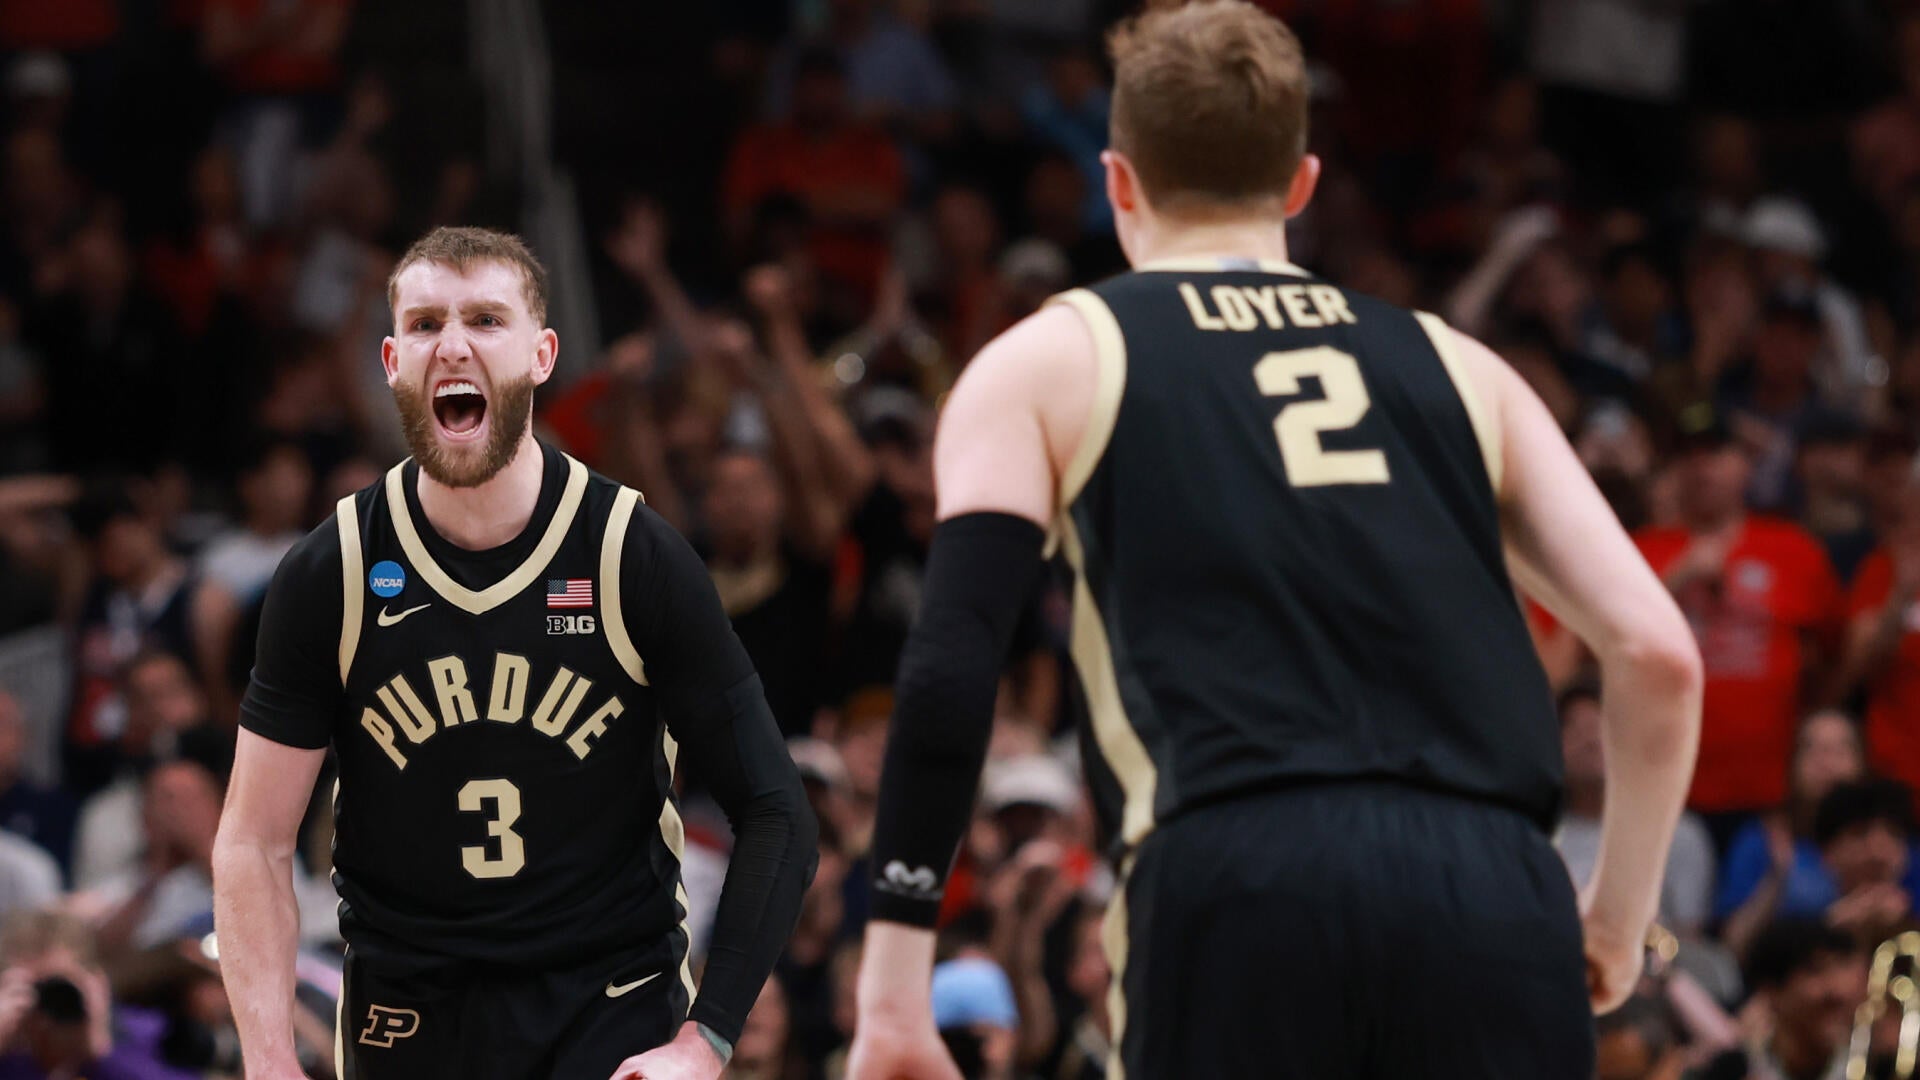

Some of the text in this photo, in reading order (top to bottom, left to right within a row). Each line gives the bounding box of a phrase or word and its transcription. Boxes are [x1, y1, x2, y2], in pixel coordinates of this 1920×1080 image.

[1177, 282, 1357, 331] LOYER
[1253, 345, 1390, 487] 2
[373, 577, 403, 588] NCAA
[360, 652, 625, 771] PURDUE
[457, 778, 525, 879] 3
[358, 1004, 420, 1048] P
